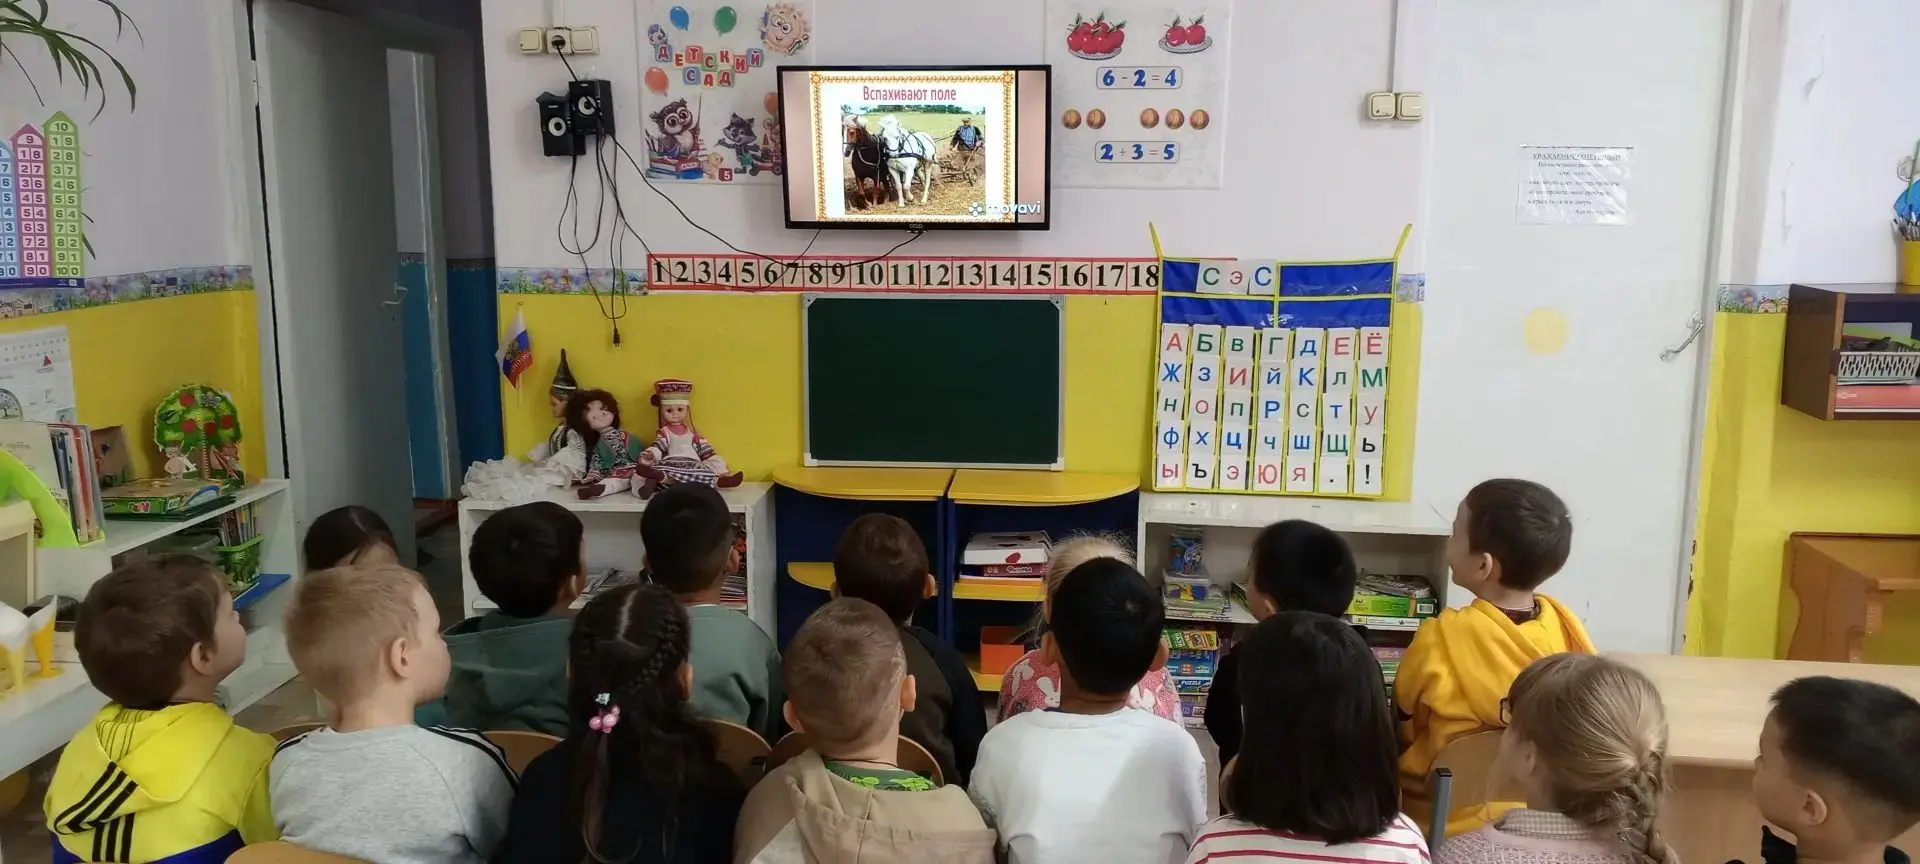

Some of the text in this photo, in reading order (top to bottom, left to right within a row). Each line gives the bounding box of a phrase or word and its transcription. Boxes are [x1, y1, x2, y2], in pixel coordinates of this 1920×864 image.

[659, 45, 760, 70] ДЕТСКИЙ
[687, 70, 731, 86] САД
[1103, 70, 1115, 86] 6
[1134, 69, 1146, 87] 2
[1165, 69, 1176, 86] 4
[863, 86, 957, 102] Вспахивают поле
[55, 123, 68, 131] 10
[65, 137, 72, 145] 9
[21, 150, 26, 158] 1
[53, 152, 60, 160] 2
[1100, 144, 1113, 160] 2
[1132, 144, 1143, 160] 3
[1163, 144, 1175, 160] 5
[1, 164, 8, 172] 7
[21, 165, 41, 173] 2 7
[54, 166, 73, 175] 3 7
[723, 170, 731, 180] 5
[35, 180, 42, 188] 6
[54, 181, 61, 189] 4
[4, 193, 11, 201] 5
[23, 194, 29, 202] 4
[68, 196, 75, 204] 5
[5, 208, 12, 216] 4
[24, 209, 30, 217] 5
[56, 210, 63, 218] 6
[6, 223, 13, 231] 3
[37, 224, 44, 232] 3
[7, 238, 13, 246] 2
[70, 239, 77, 247] 2
[57, 267, 67, 275] 10
[654, 261, 1159, 287] 1 2 3 4 5 6 7 8 9 10 11 12 13 14 15 16 17 18
[1165, 333, 1183, 351] А
[1196, 333, 1213, 352] Б
[1269, 337, 1283, 354] Г
[1335, 337, 1350, 355] Е
[1367, 333, 1382, 354] Ё
[1162, 363, 1183, 382] Ж
[1229, 368, 1246, 385] И
[1299, 368, 1315, 385] К
[1362, 369, 1383, 387] М
[1265, 401, 1280, 418] Р
[1327, 435, 1348, 456] Щ
[1258, 464, 1277, 484] Ю
[1365, 465, 1370, 484] !
